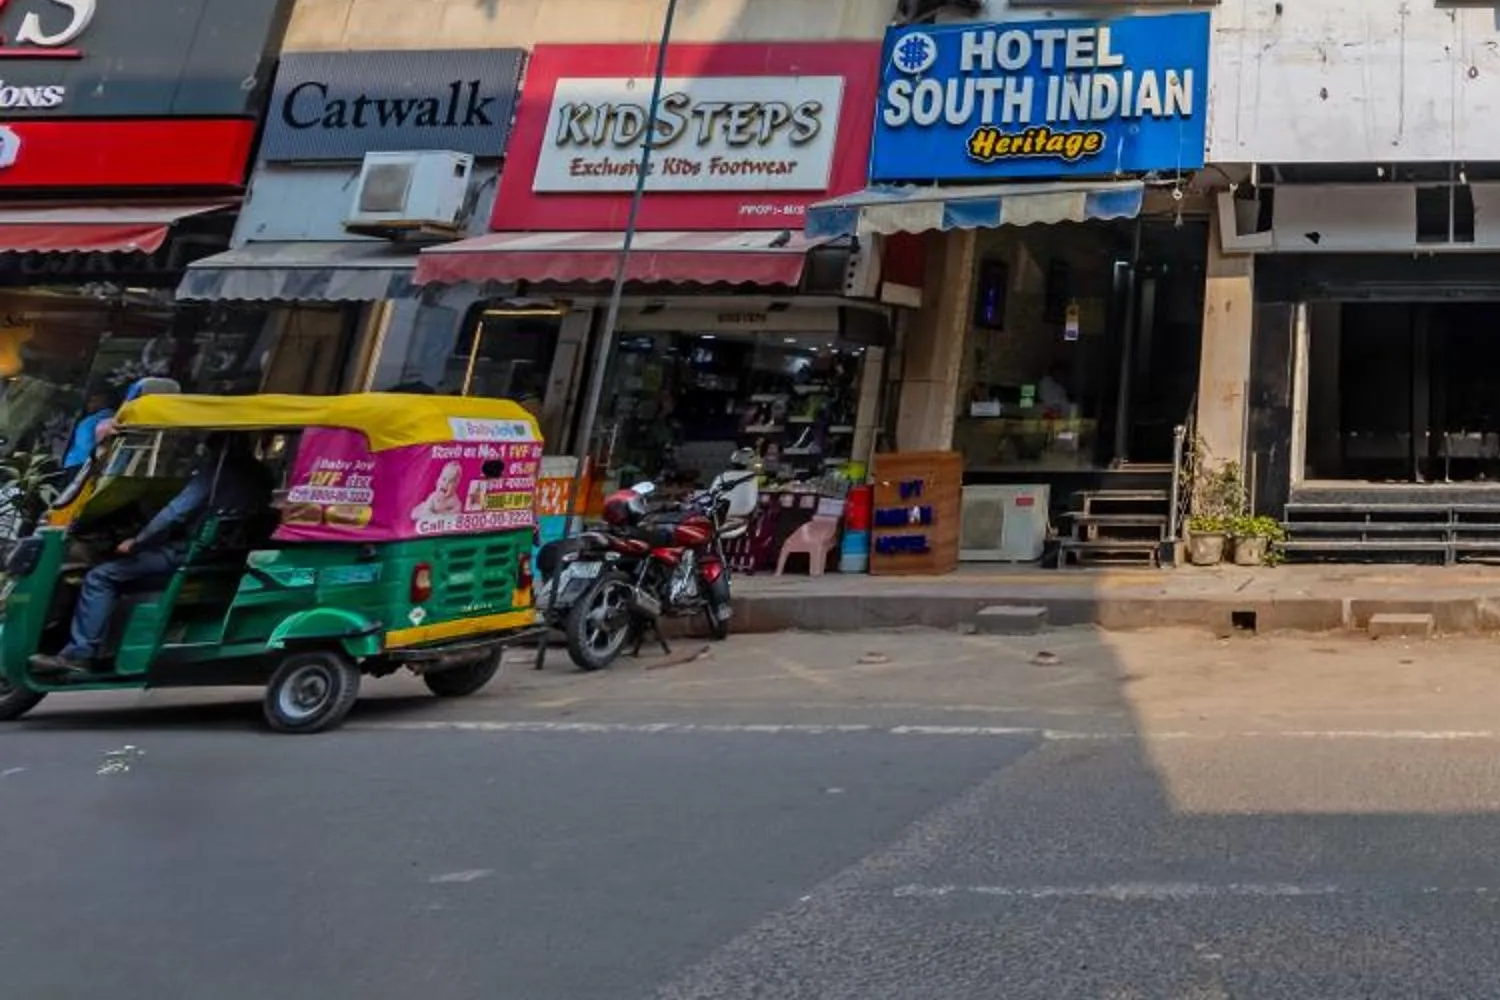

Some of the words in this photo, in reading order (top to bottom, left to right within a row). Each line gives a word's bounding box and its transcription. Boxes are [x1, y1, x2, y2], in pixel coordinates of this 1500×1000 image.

[959, 26, 1124, 72] HOTEL
[282, 80, 497, 130] Catwalk
[883, 75, 1035, 127] SOUTH
[1046, 68, 1194, 122] INDIAN
[968, 127, 1103, 160] Heritage
[662, 157, 702, 176] Kids
[708, 156, 798, 176] Footwear
[420, 520, 445, 533] Call
